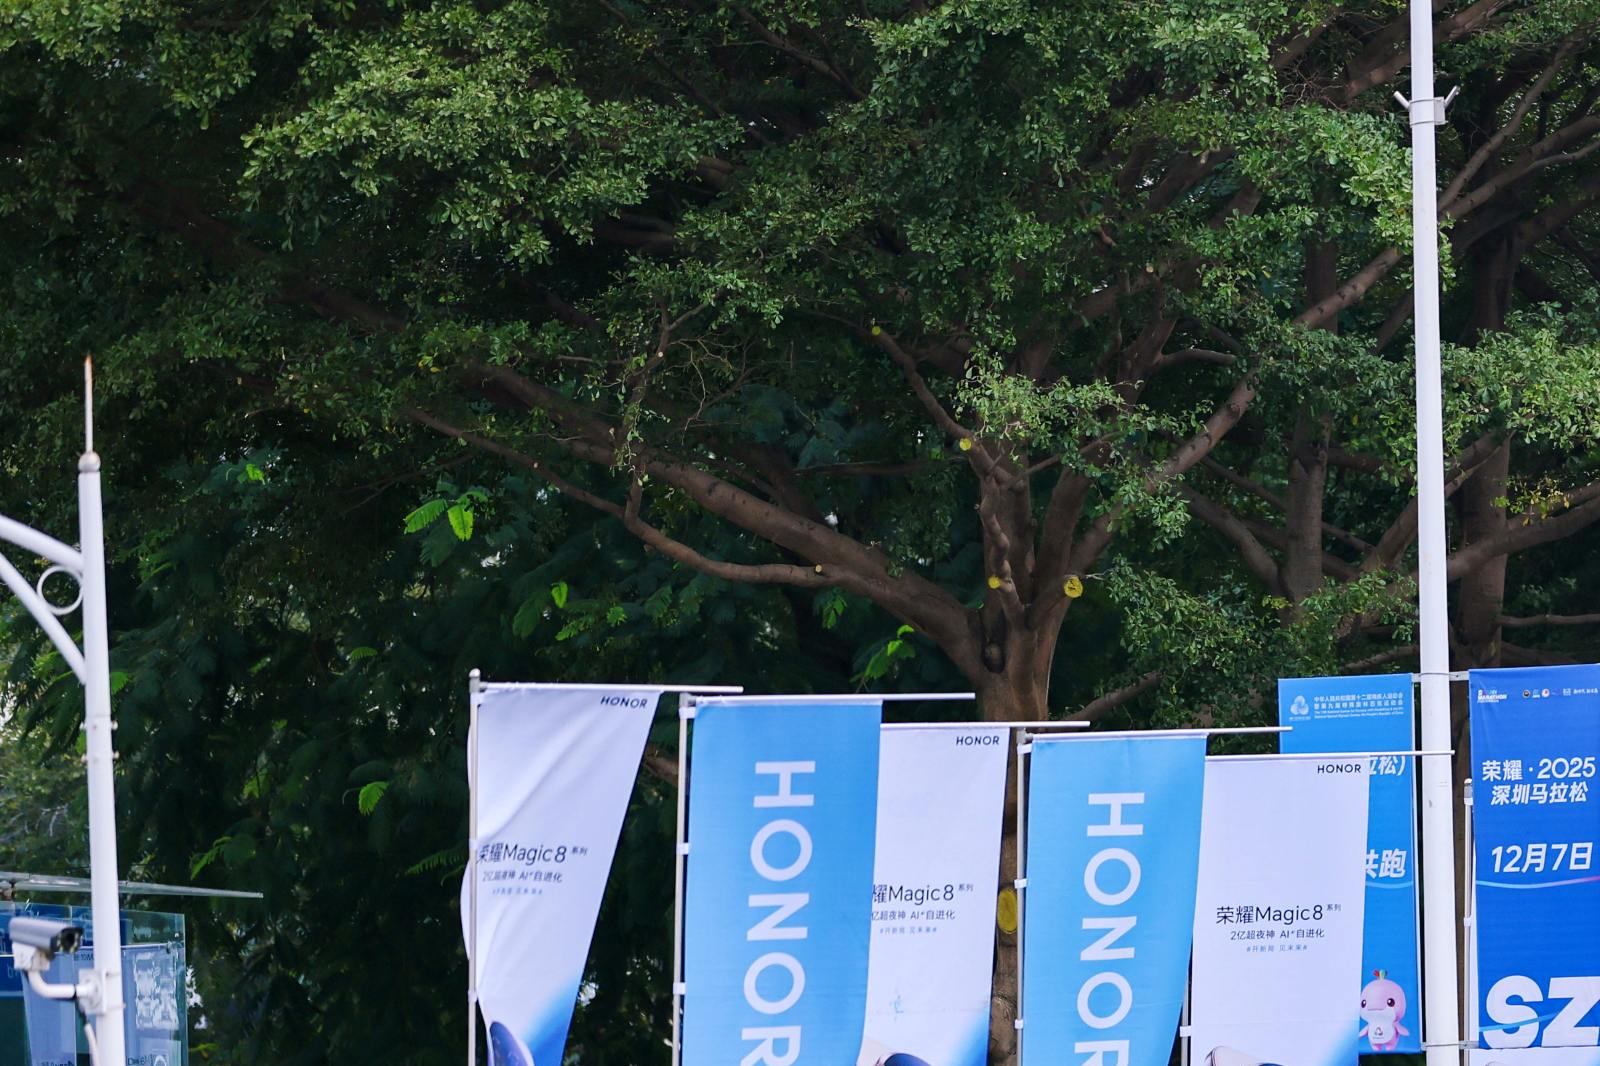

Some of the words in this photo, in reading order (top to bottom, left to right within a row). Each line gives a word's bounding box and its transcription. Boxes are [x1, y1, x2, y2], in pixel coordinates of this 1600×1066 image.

[601, 695, 648, 709] HONOR
[956, 735, 1000, 746] HONOR
[1317, 763, 1362, 774] HONOR
[1491, 782, 1588, 806] 深圳马拉松
[1491, 843, 1593, 873] 12月7日
